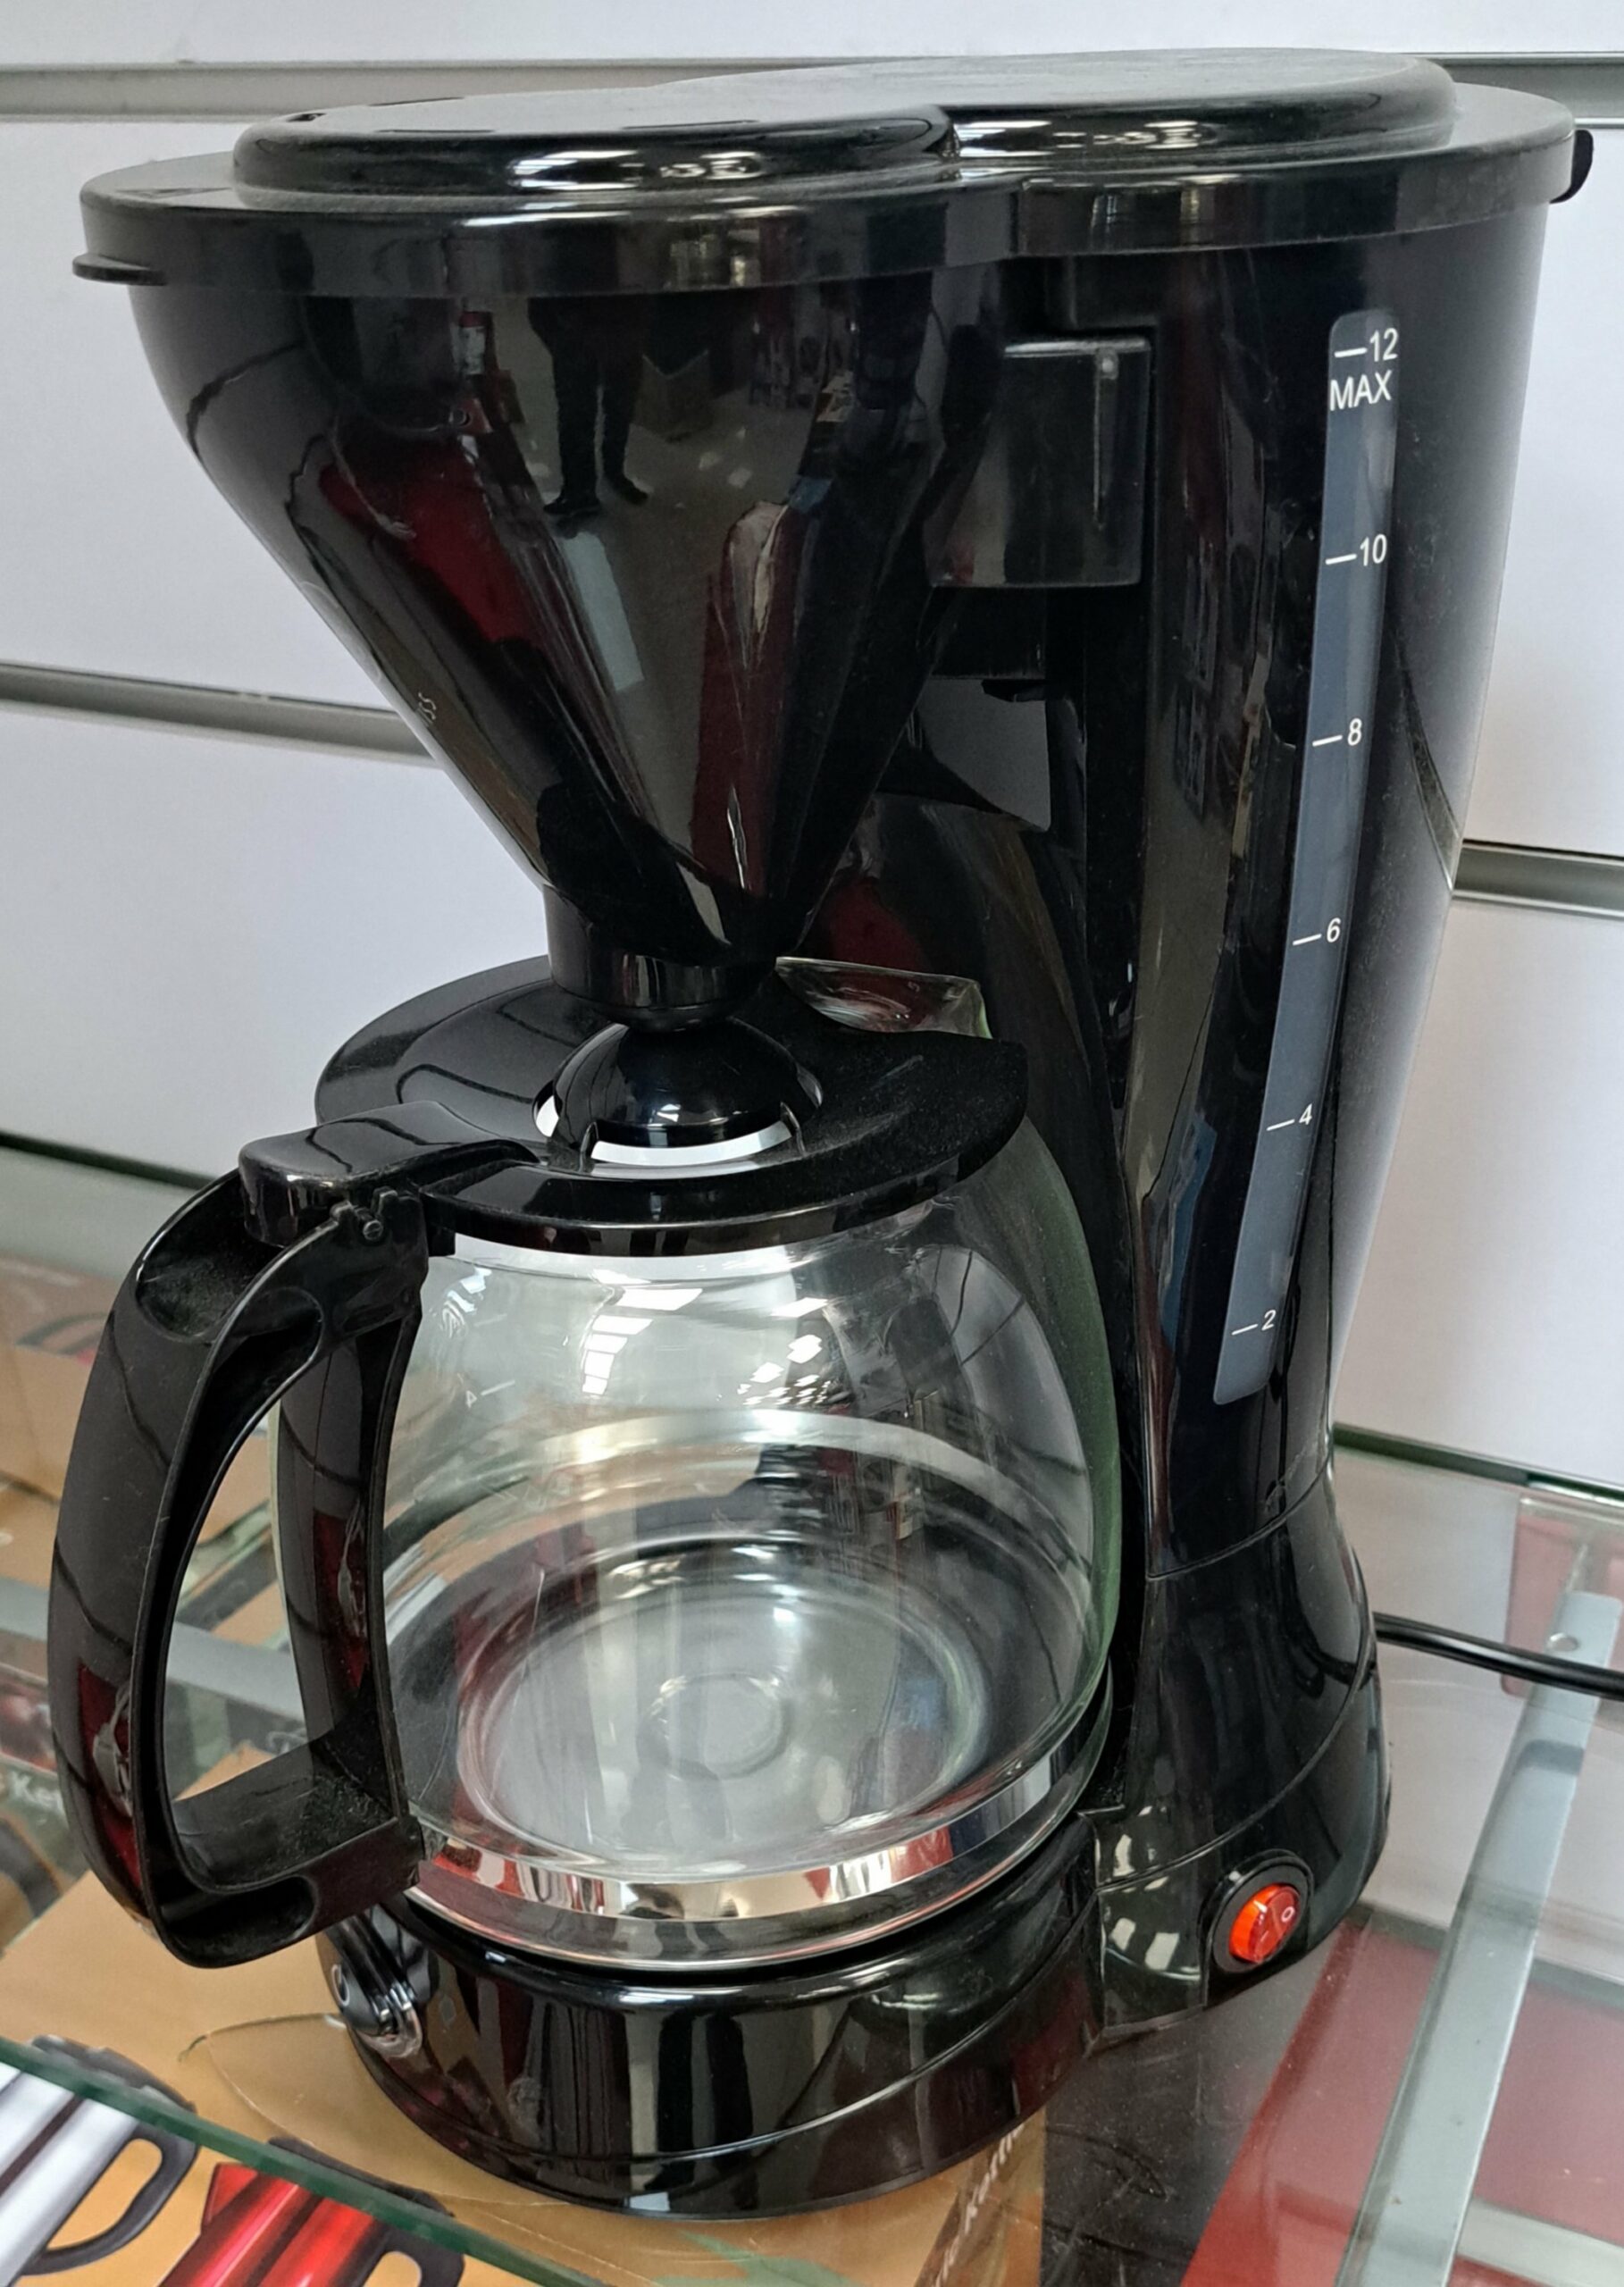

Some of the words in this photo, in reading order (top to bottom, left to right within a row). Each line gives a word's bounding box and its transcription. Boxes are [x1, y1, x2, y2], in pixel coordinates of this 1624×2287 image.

[1369, 327, 1398, 362] 12
[1329, 370, 1392, 411] MAX
[1360, 533, 1387, 566] 10
[1347, 717, 1362, 746] 8
[1327, 917, 1341, 942] 6
[1298, 1103, 1312, 1125] 4
[1261, 1310, 1277, 1331] 2
